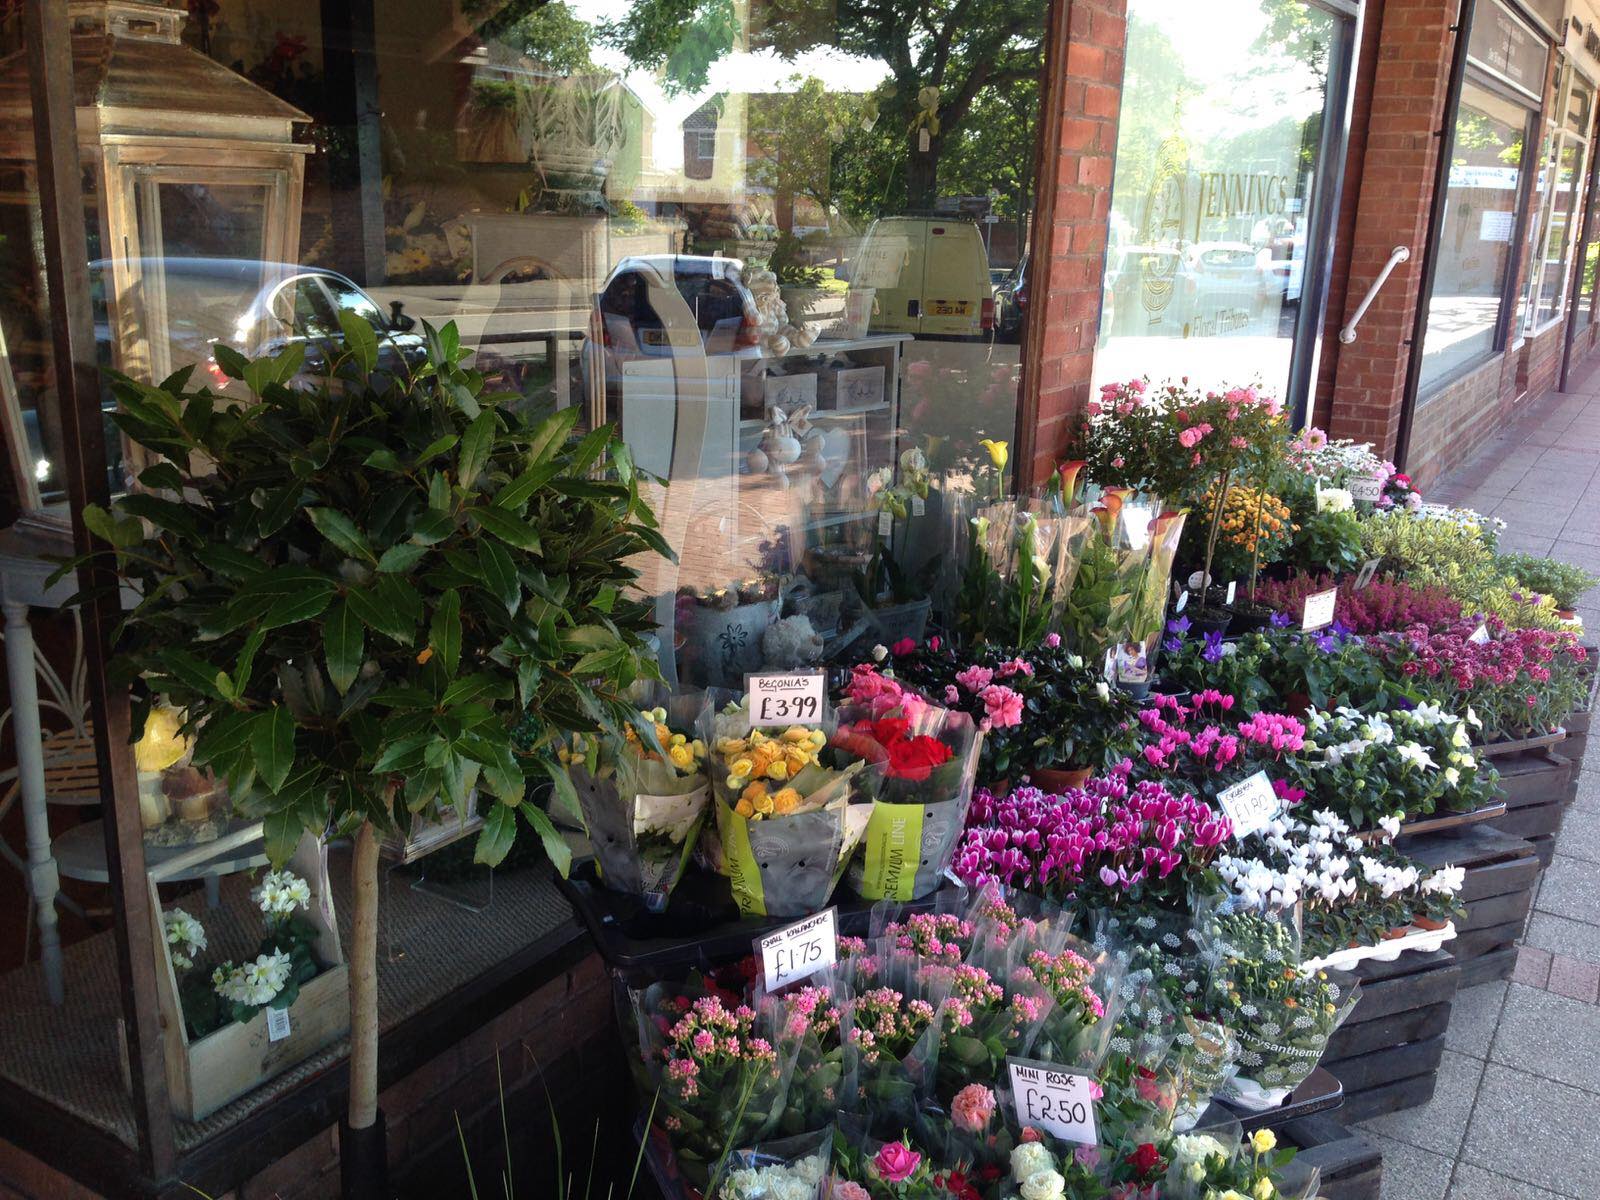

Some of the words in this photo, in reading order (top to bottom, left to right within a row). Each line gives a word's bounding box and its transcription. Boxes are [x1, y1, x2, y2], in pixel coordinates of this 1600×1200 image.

[1194, 172, 1287, 245] JENNINGS
[883, 849, 904, 900] REMIUM
[1015, 1066, 1040, 1081] MINI
[1045, 1071, 1076, 1088] ROSE
